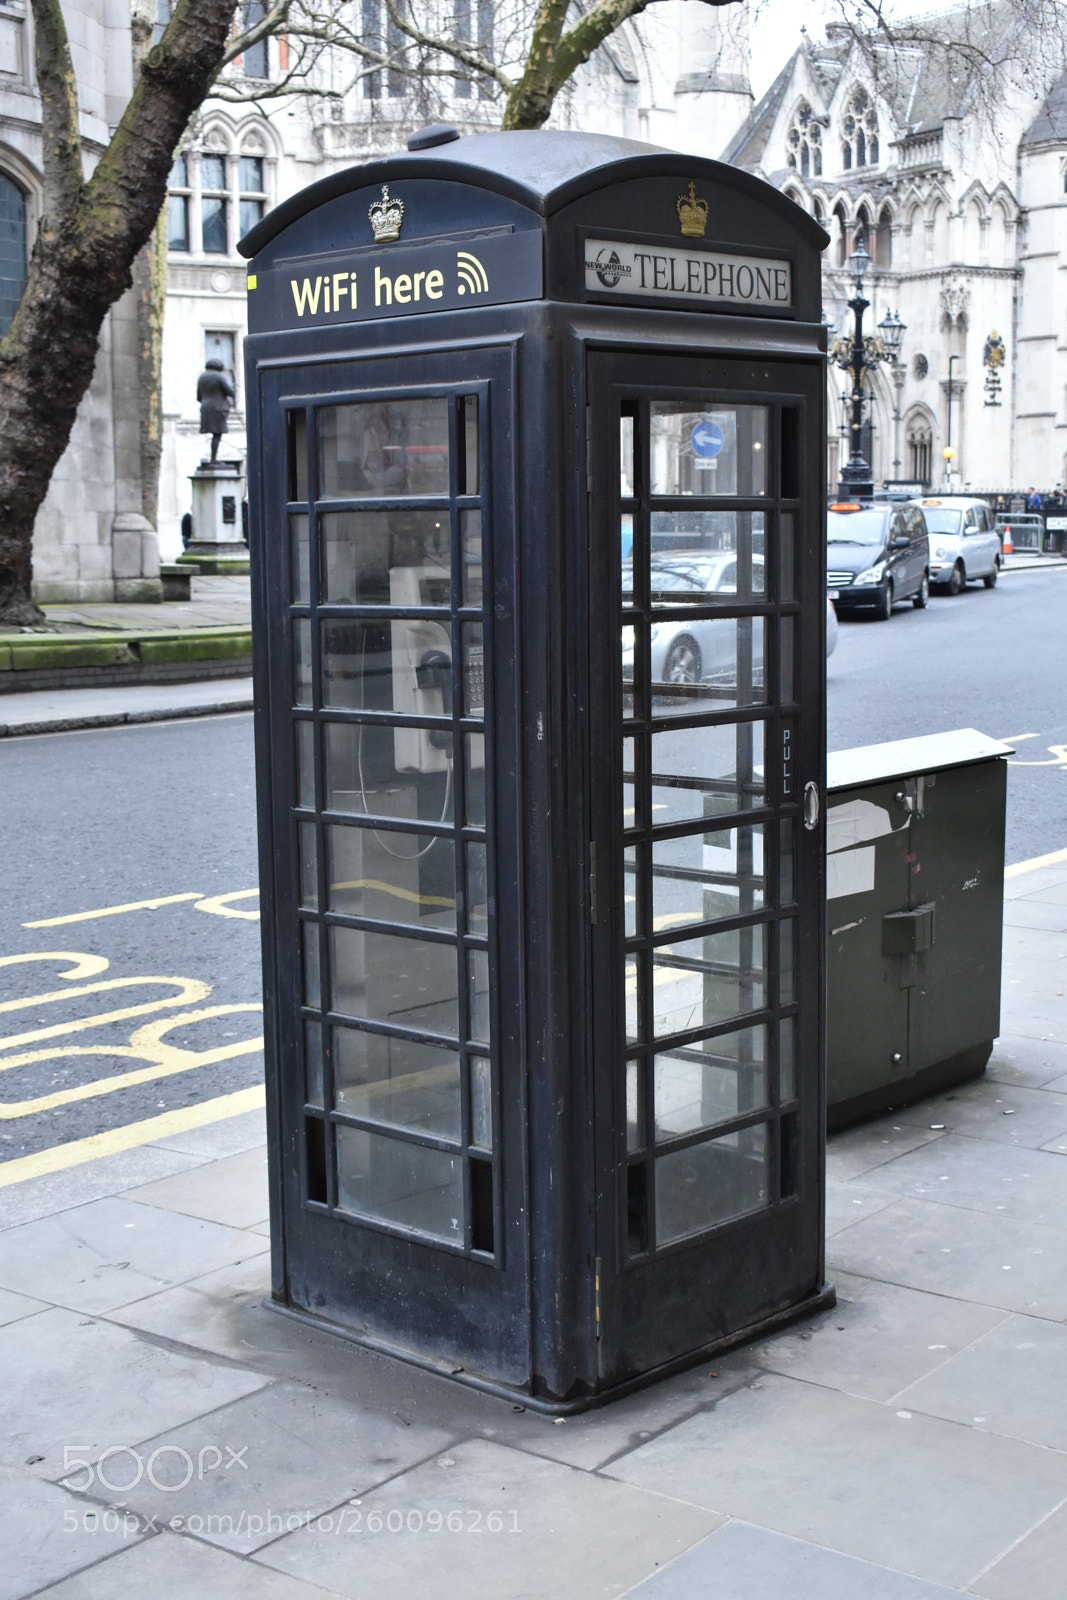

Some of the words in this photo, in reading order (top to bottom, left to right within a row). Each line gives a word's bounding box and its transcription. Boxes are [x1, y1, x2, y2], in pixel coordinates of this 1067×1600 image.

[585, 261, 602, 270] NEW
[603, 262, 632, 272] WORLD
[634, 253, 789, 301] TELEPHONE
[290, 271, 358, 317] WiFi
[374, 265, 444, 307] here
